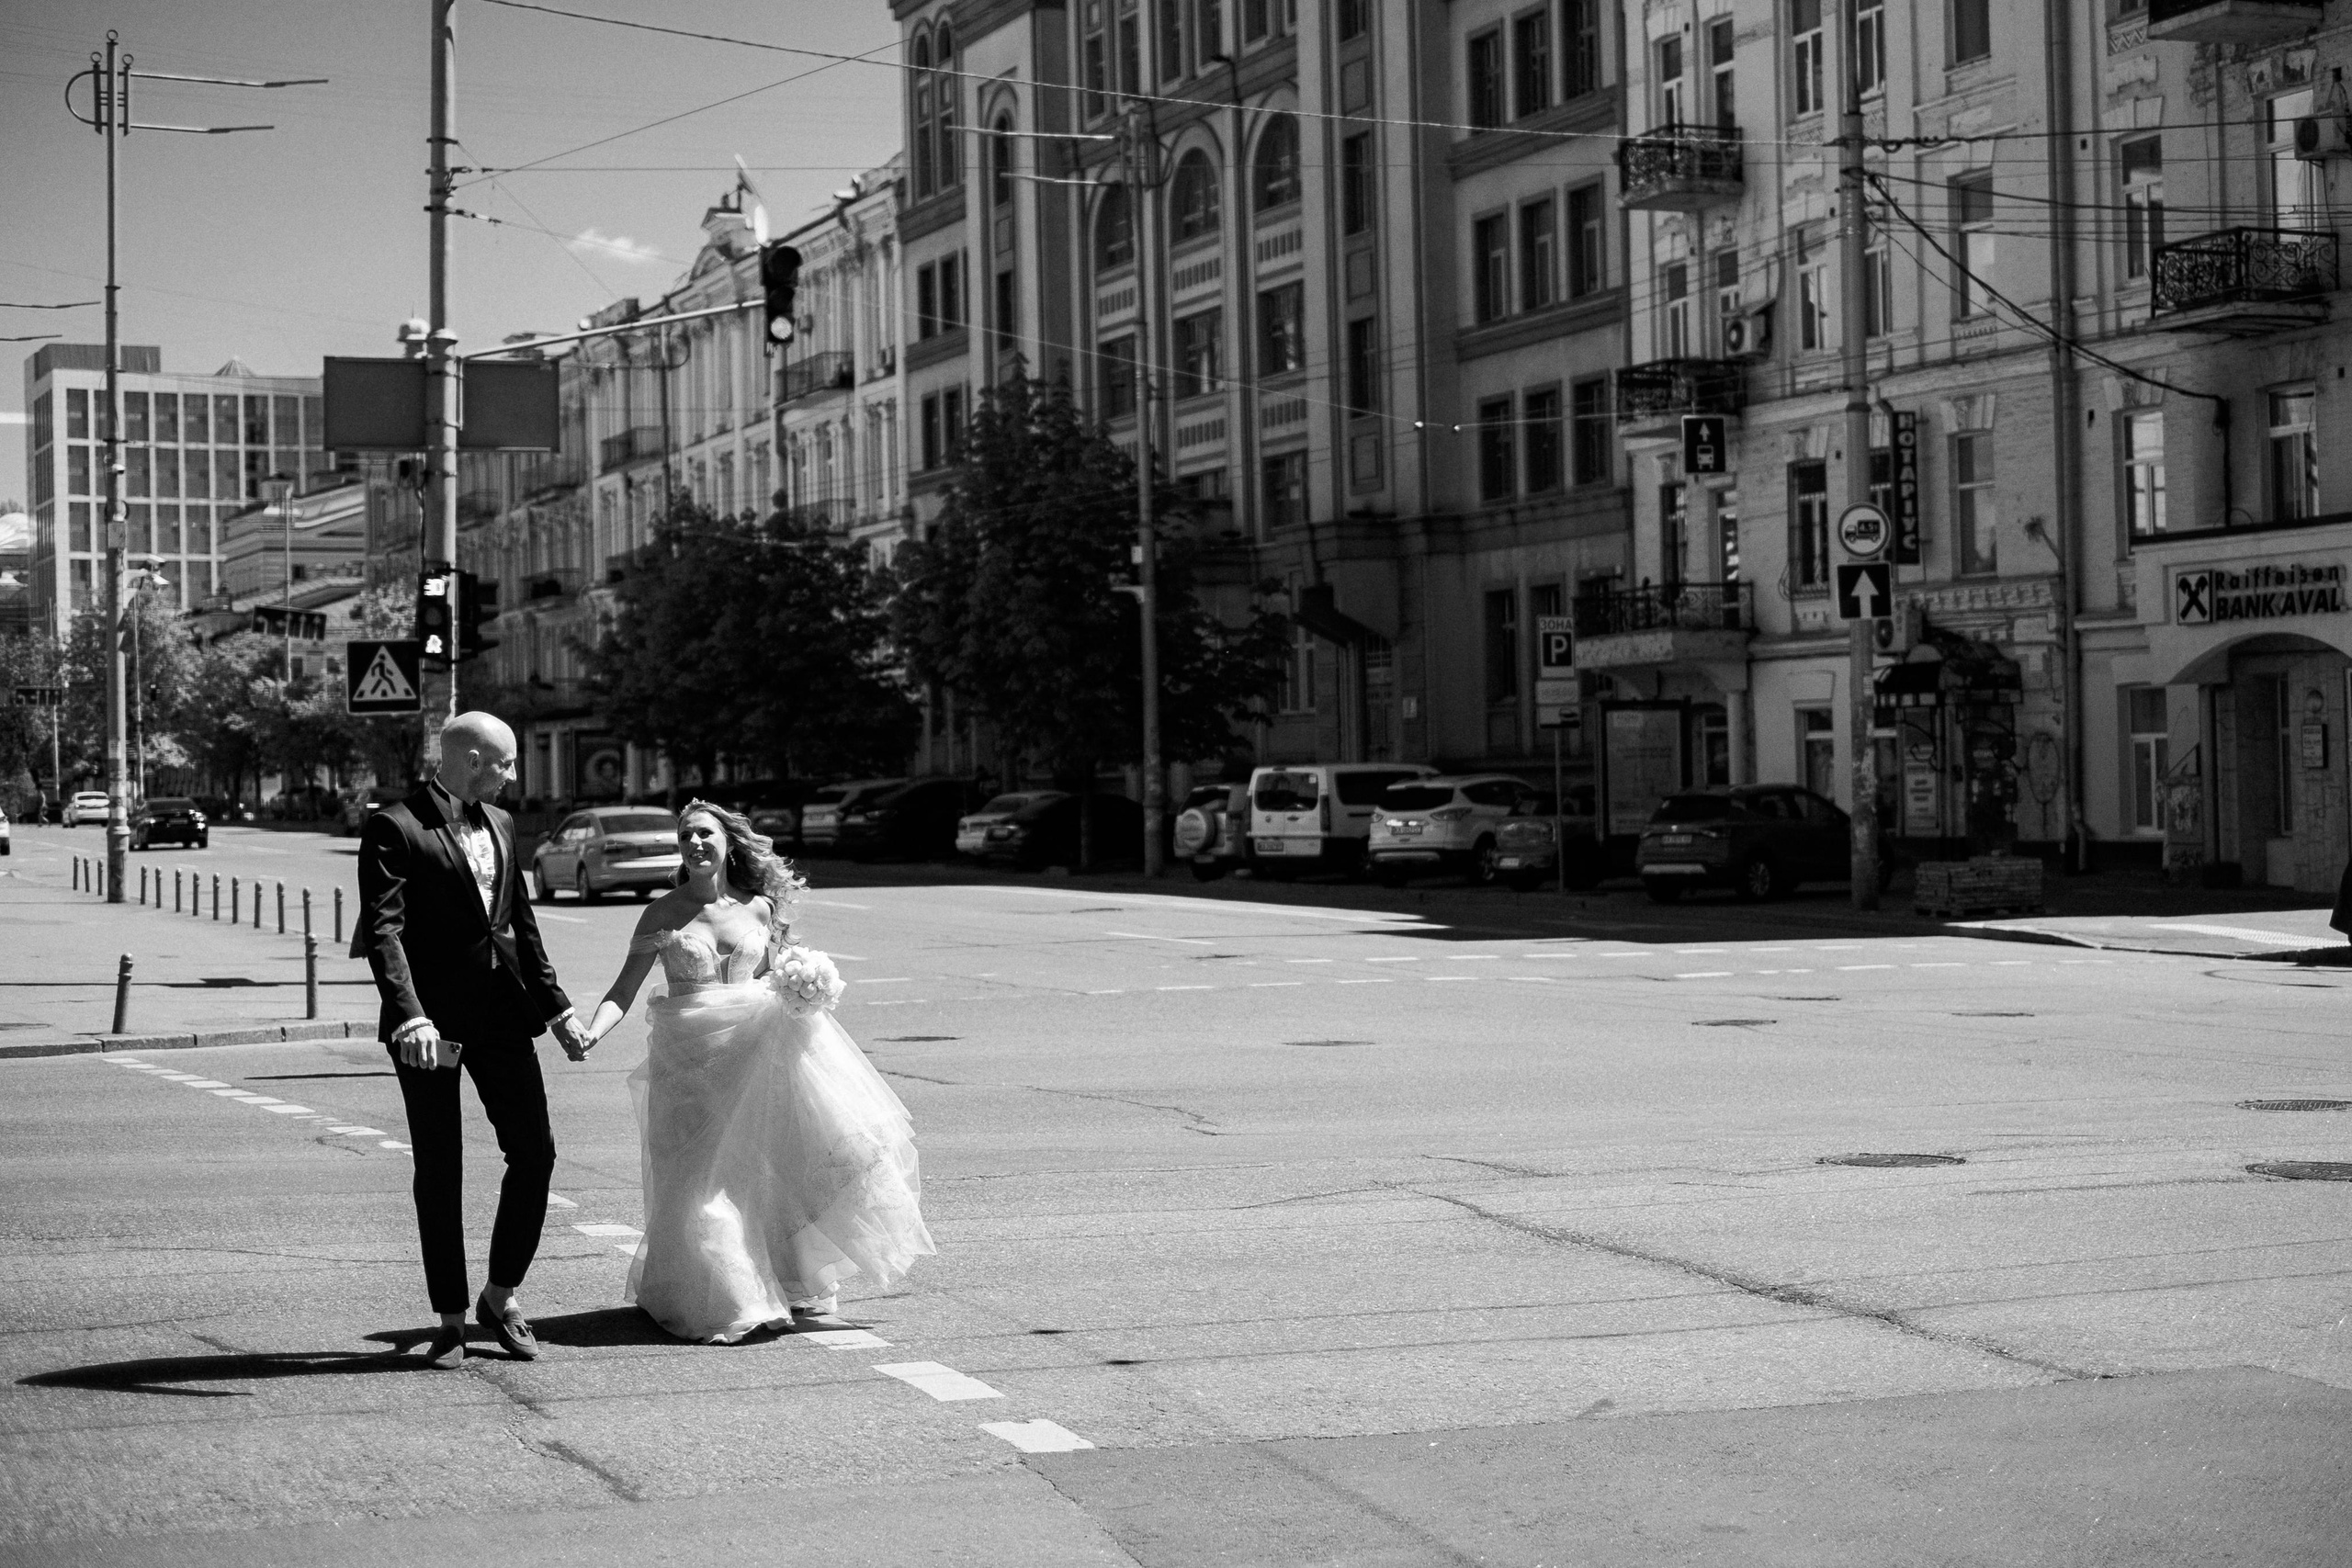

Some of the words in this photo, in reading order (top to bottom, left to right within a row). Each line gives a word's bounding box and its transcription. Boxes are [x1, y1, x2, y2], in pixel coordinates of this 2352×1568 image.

[1897, 412, 1917, 550] НОТАРІУС
[2215, 564, 2340, 590] Raiffeisen
[2215, 592, 2276, 621] BANK
[2279, 587, 2341, 616] AVAL
[1539, 618, 1573, 631] ЗОНА
[1550, 635, 1568, 663] P
